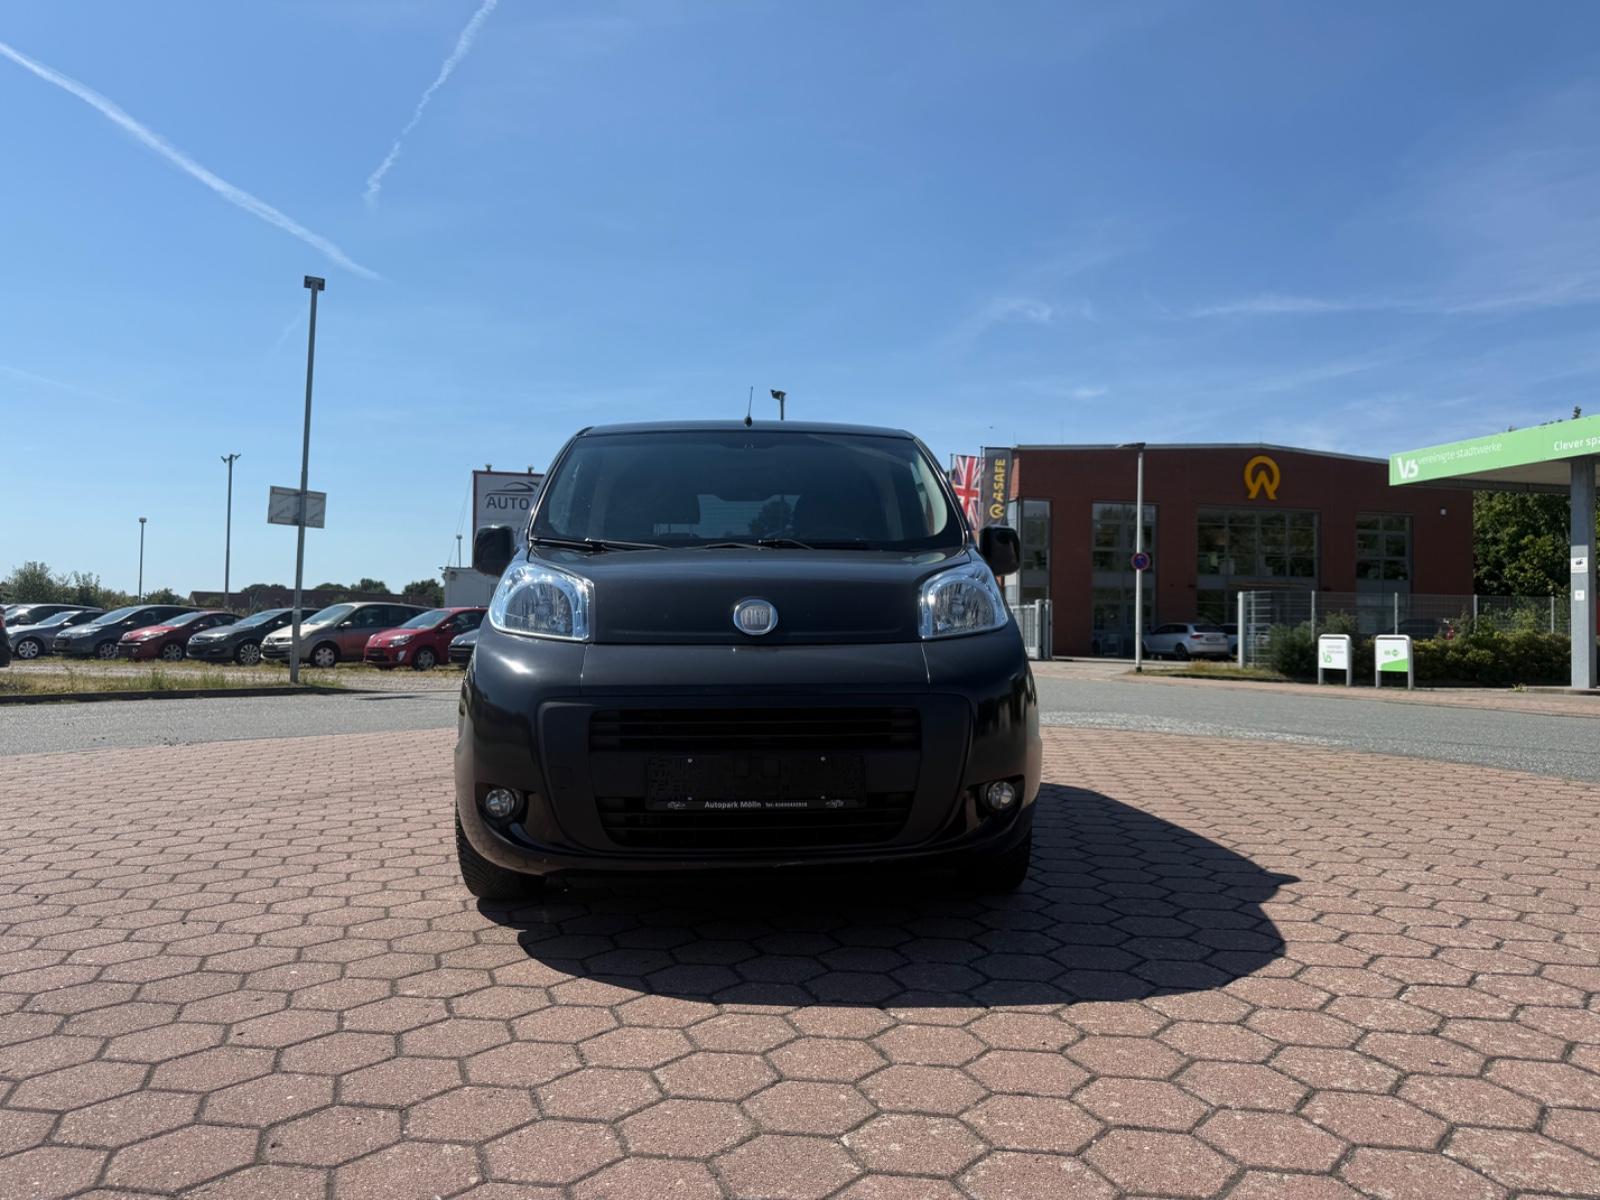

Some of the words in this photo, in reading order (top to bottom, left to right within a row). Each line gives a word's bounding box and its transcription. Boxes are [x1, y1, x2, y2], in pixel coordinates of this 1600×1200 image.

[1553, 439, 1584, 451] Clever
[1417, 450, 1456, 464] vereinigte
[1456, 442, 1503, 458] stadtwerke
[992, 459, 1006, 502] A-SAFE
[486, 497, 530, 510] AUTO
[704, 801, 739, 810] Autopark
